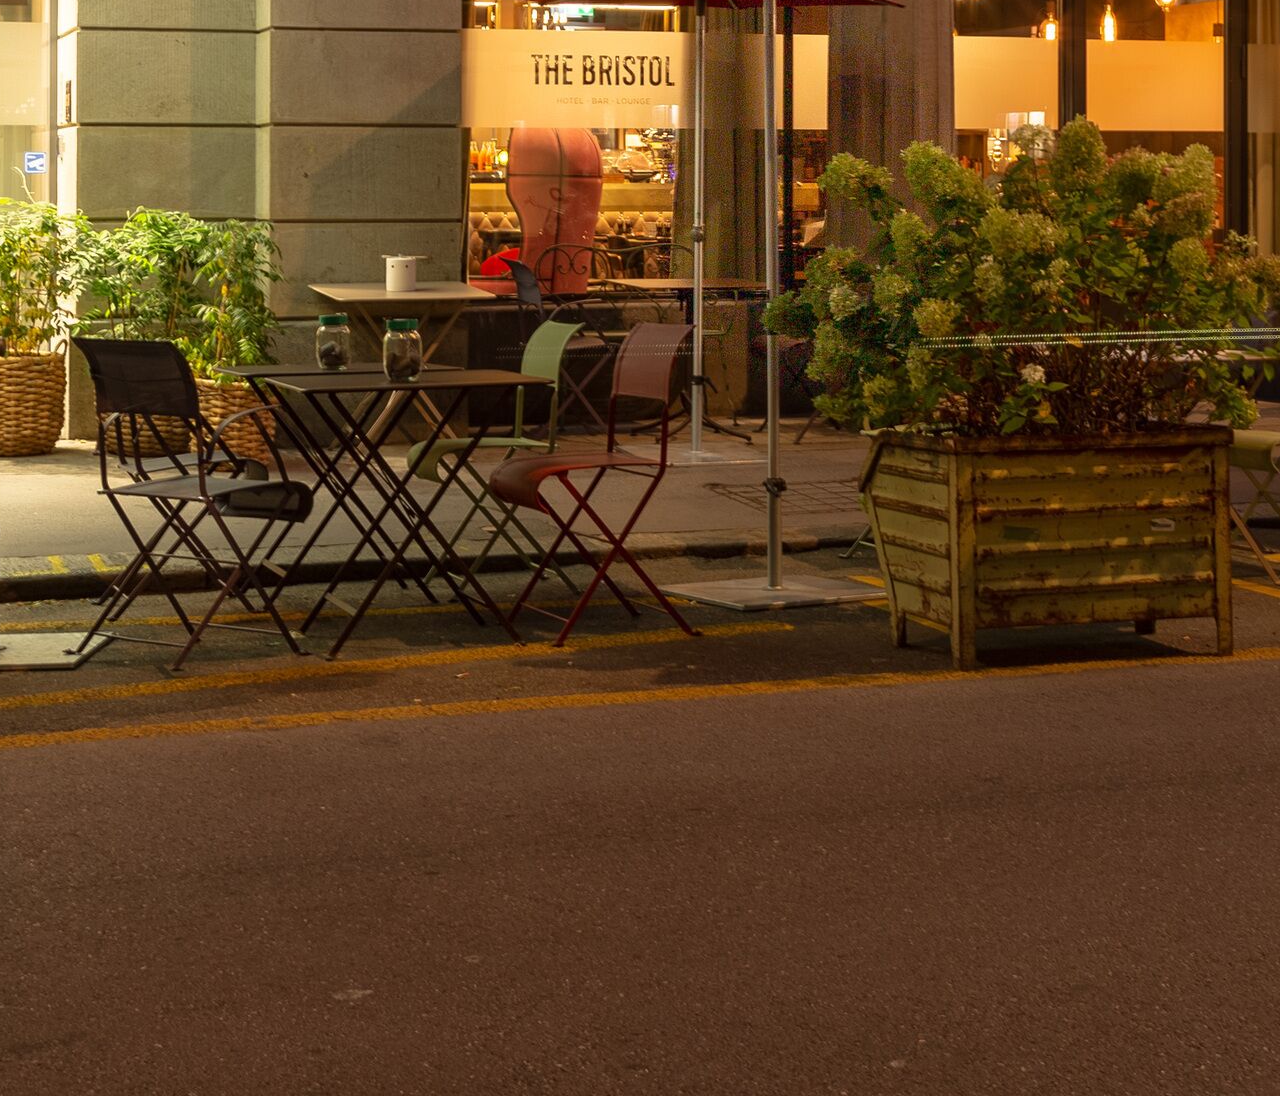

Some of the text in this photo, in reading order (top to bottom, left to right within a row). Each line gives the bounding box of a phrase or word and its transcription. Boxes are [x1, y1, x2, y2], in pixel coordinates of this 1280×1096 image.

[531, 54, 675, 87] THE BRISTOL
[556, 97, 652, 105] HOTEL BAR LOUNGE
